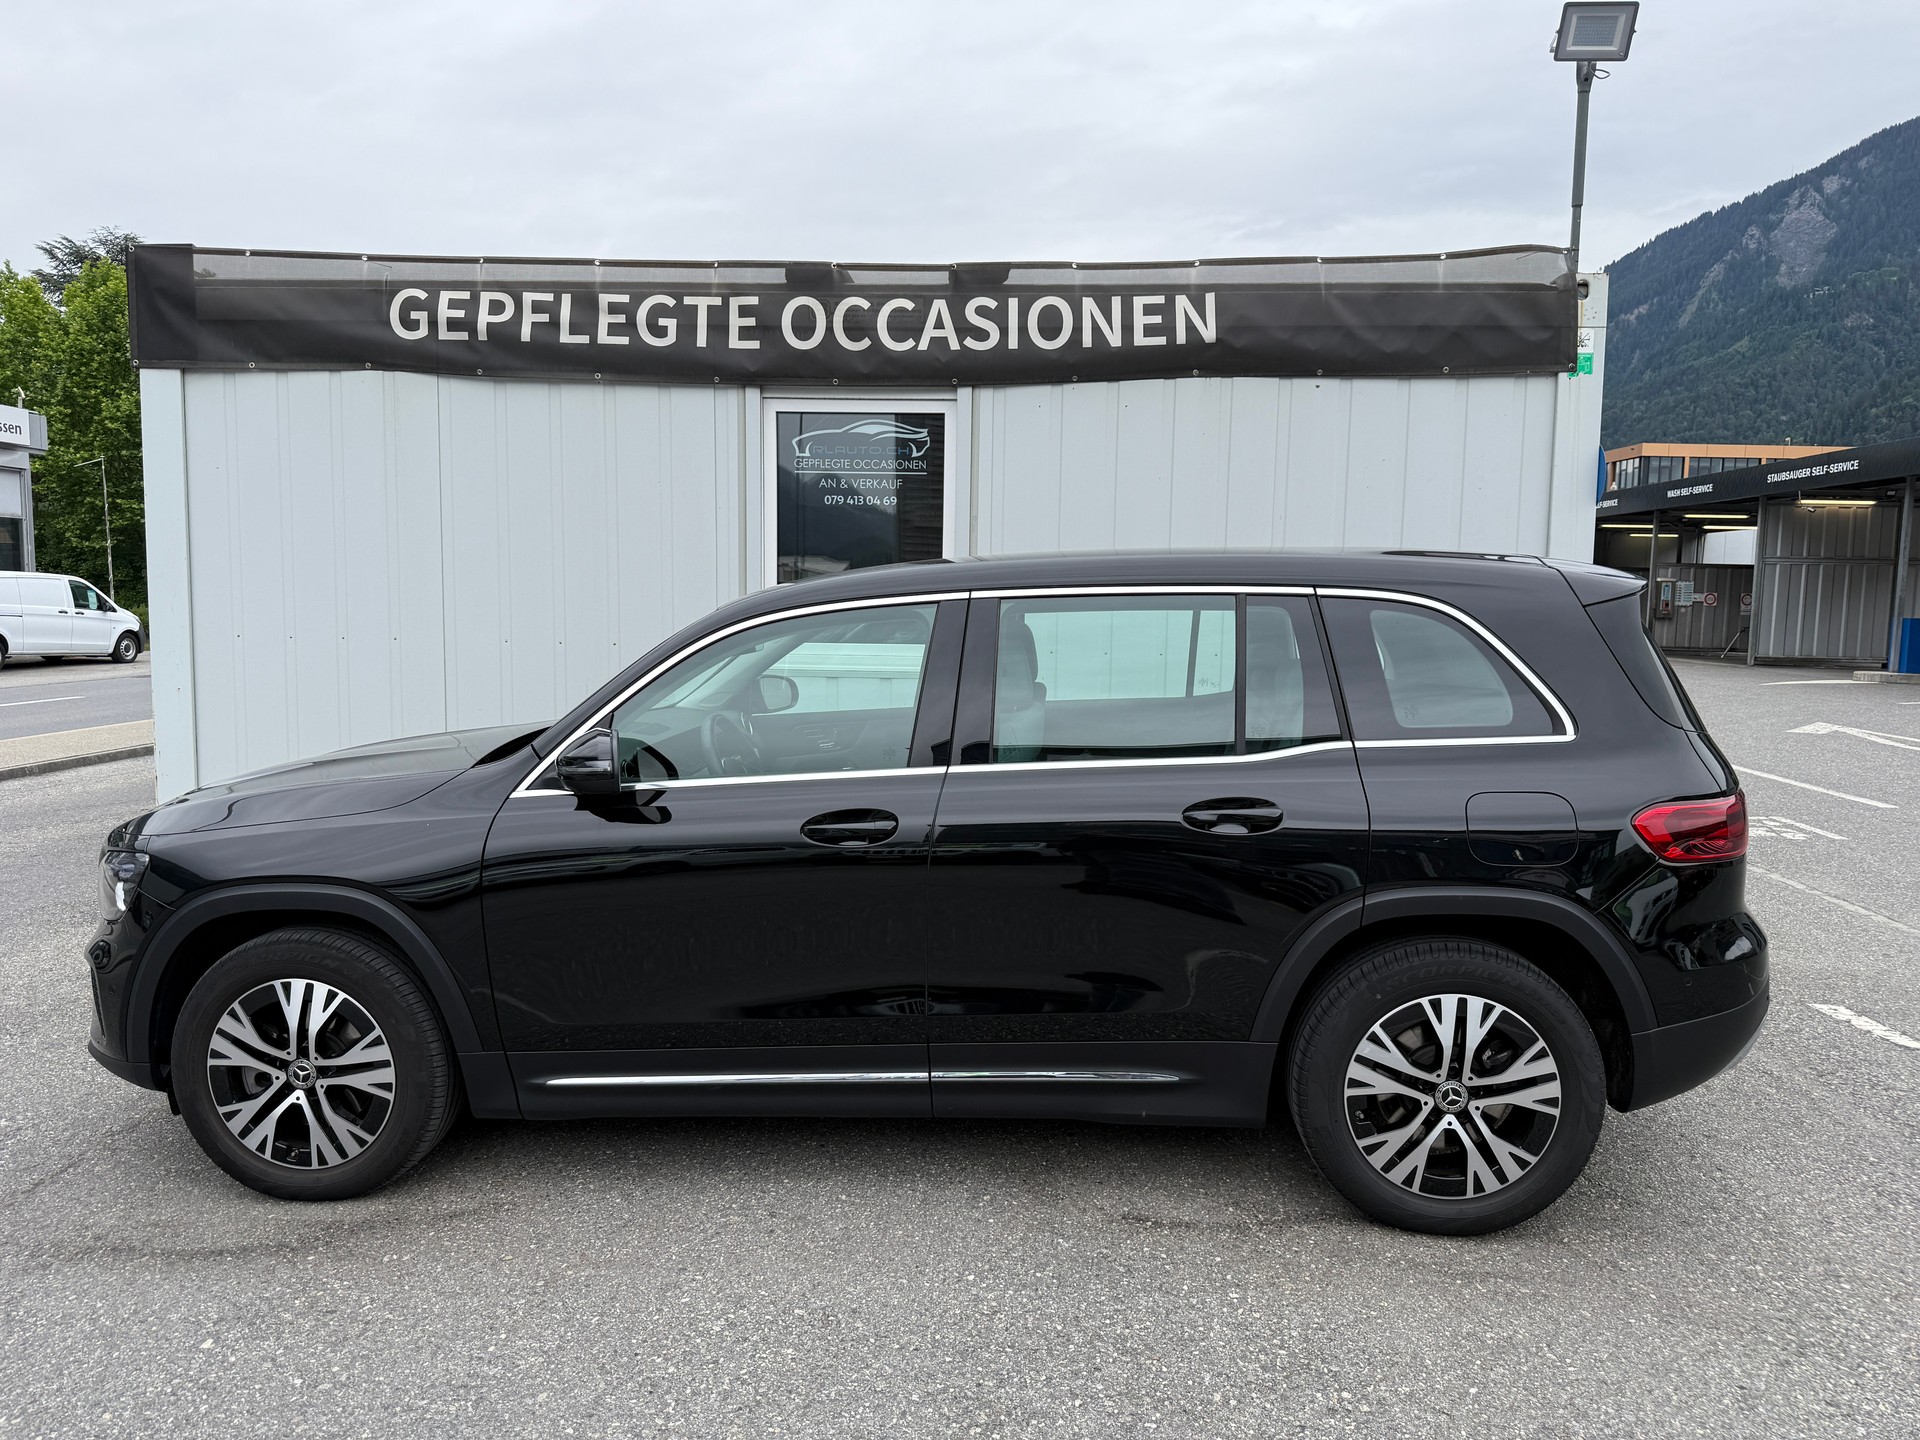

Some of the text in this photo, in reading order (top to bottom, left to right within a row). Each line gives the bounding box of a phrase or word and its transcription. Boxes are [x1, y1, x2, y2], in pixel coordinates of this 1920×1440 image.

[388, 287, 762, 351] GEPFLEGTE
[780, 290, 1219, 352] OCCASIONEN
[812, 445, 910, 455] RLAUTO.CH
[794, 458, 927, 470] GEPFLEGTE OCCASIONEN
[1766, 459, 1860, 484] STAUBSAUGER SELF-SERVICE
[818, 478, 903, 489] AN & VERKAUF
[1667, 483, 1713, 498] WASH SELF-SERVICE
[824, 495, 897, 506] 079 413 04 69
